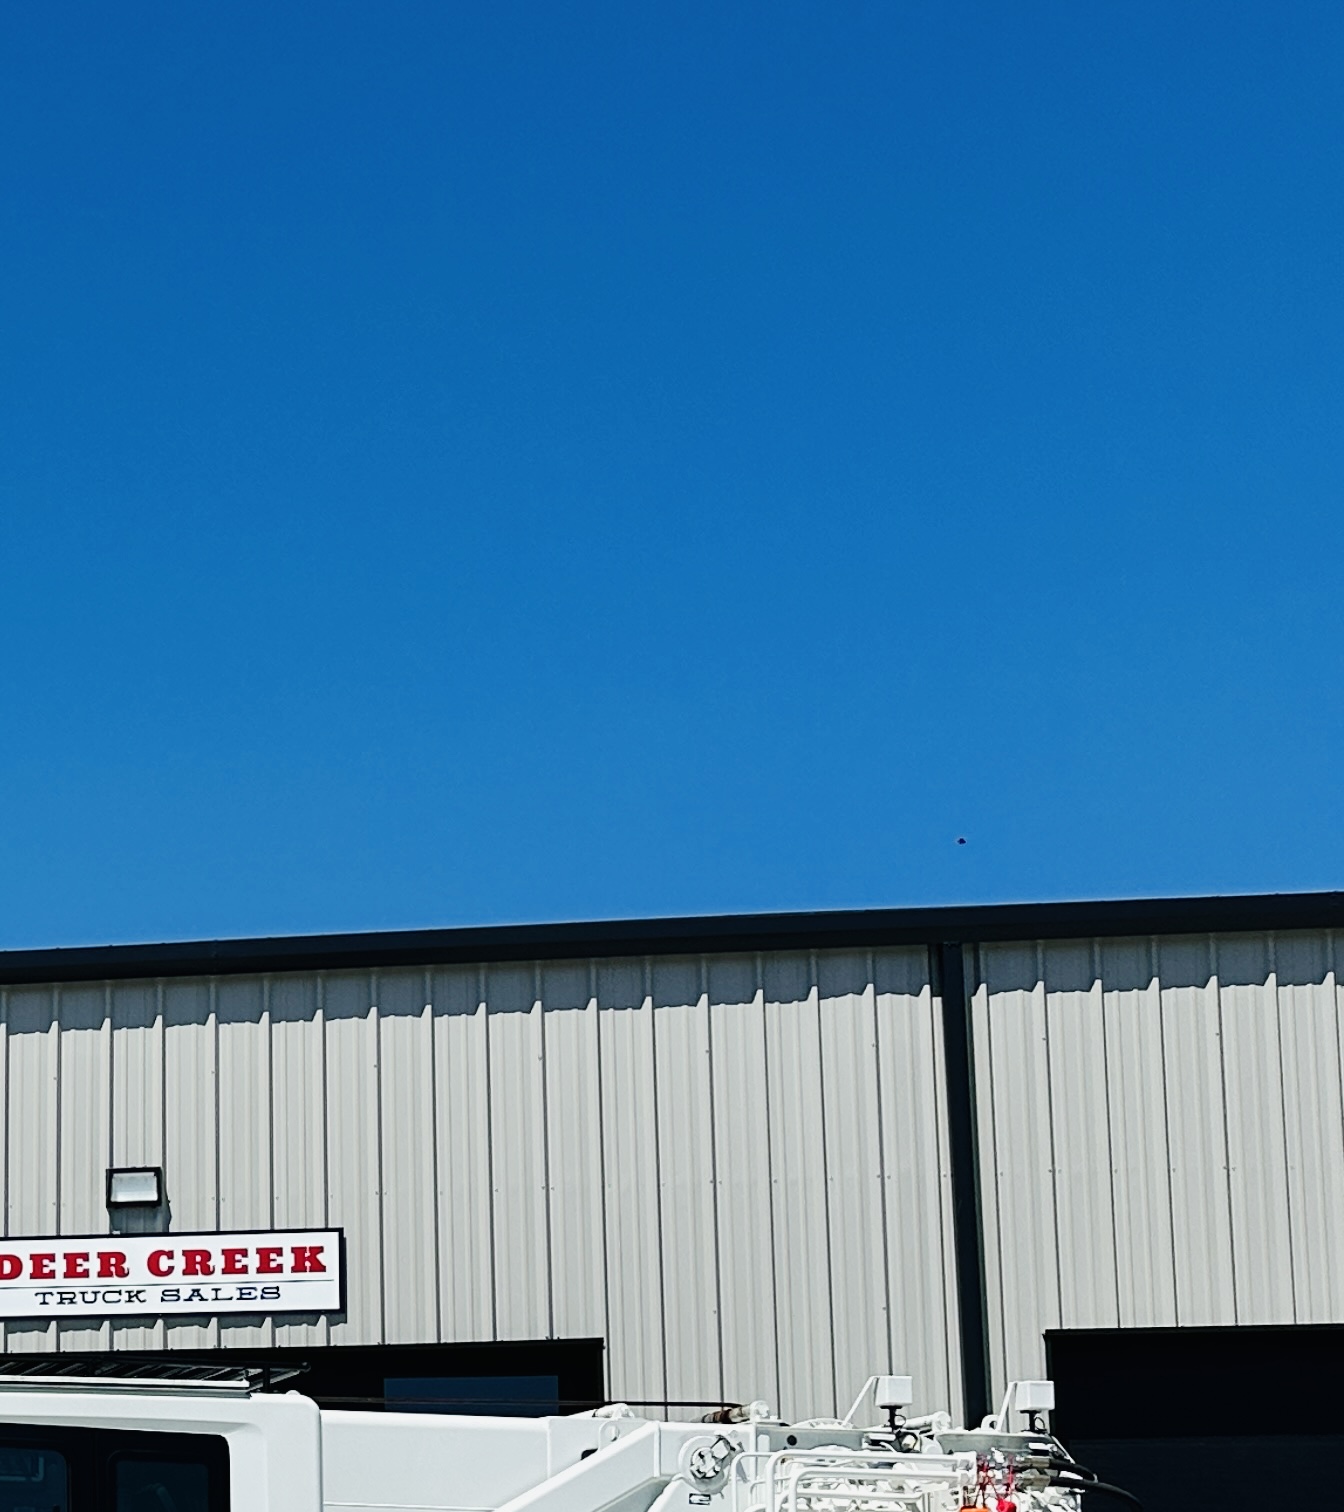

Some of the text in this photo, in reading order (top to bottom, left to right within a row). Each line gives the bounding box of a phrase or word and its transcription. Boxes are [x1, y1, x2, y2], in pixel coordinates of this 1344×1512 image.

[147, 1246, 326, 1277] CREEK
[35, 1285, 281, 1305] TRUCK SALES
